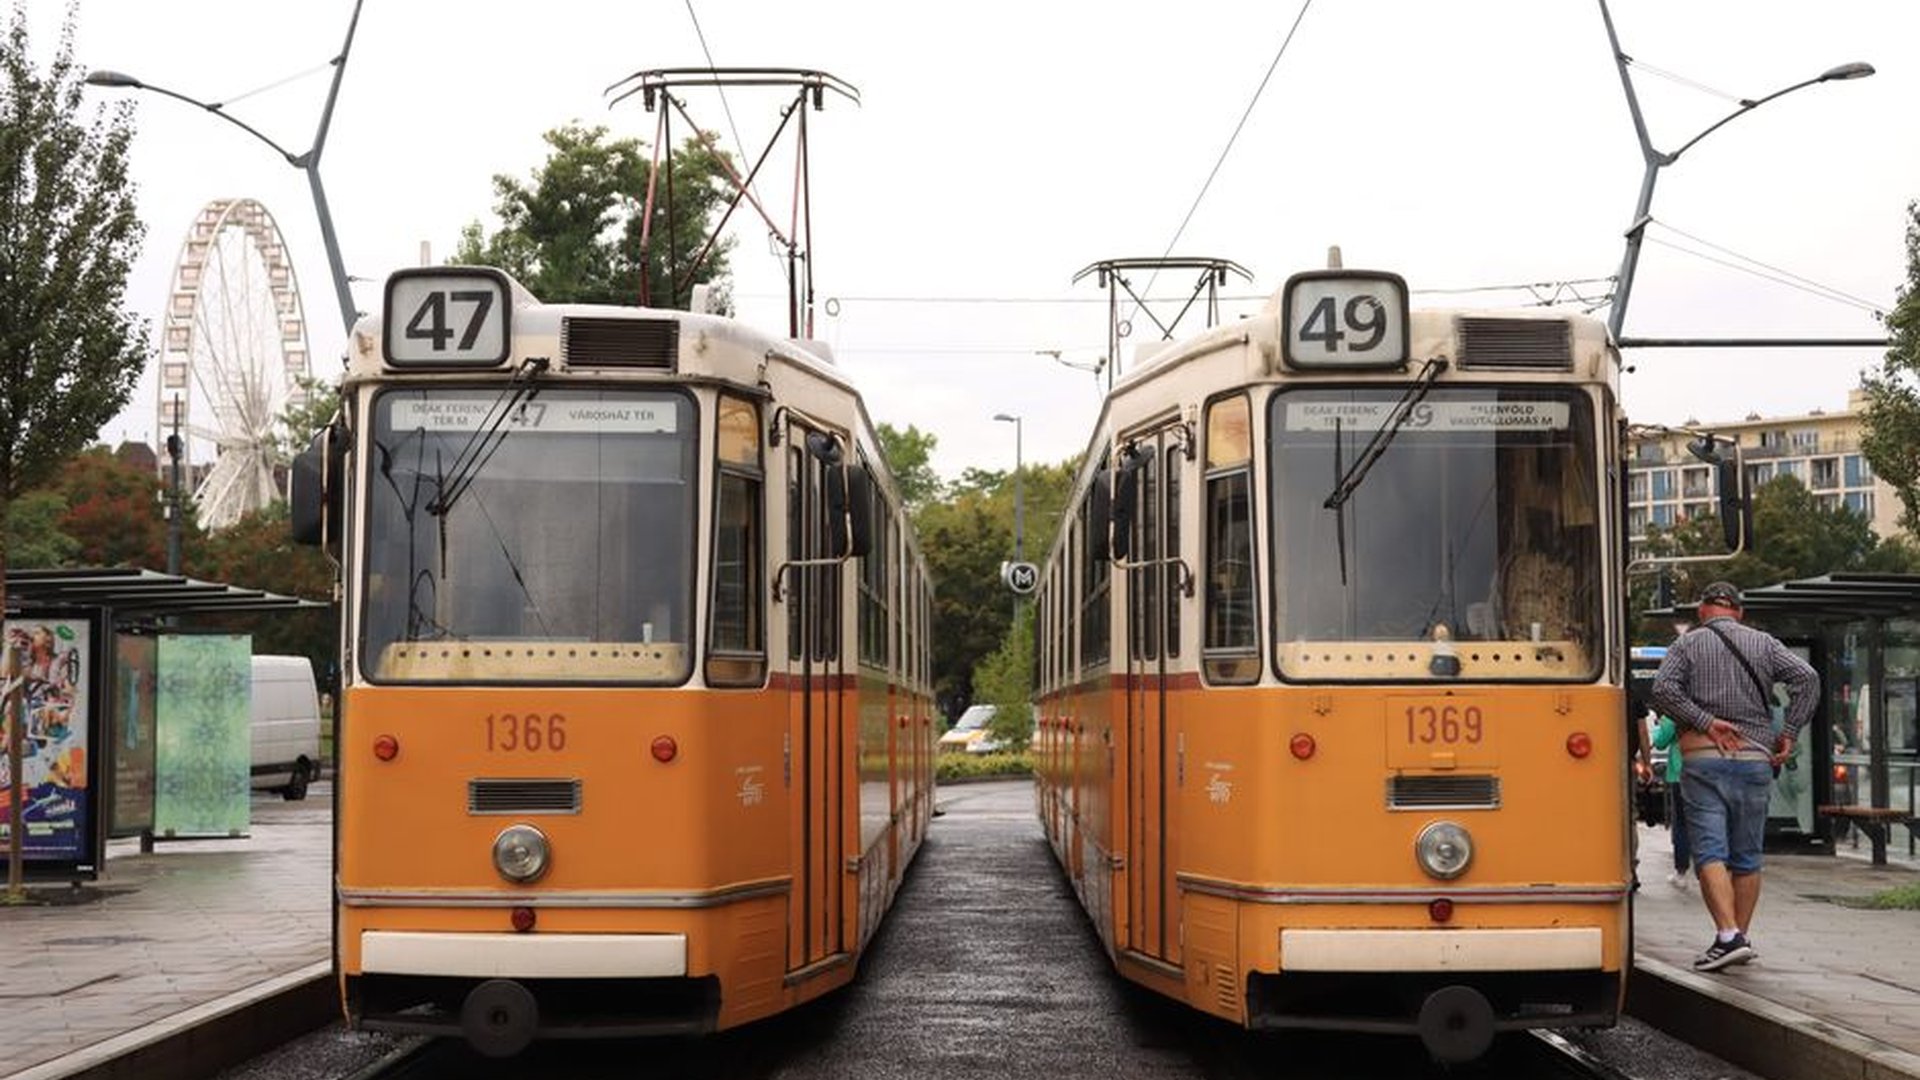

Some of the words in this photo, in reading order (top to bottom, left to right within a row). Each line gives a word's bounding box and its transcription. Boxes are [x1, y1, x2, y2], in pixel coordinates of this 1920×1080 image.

[405, 290, 494, 351] 47
[1299, 294, 1387, 353] 49
[456, 415, 469, 426] M
[511, 402, 547, 427] 47
[1324, 416, 1345, 427] TÉ
[1541, 416, 1553, 426] M
[1015, 569, 1032, 586] M
[486, 713, 566, 752] 1366
[1405, 706, 1483, 744] 1369
